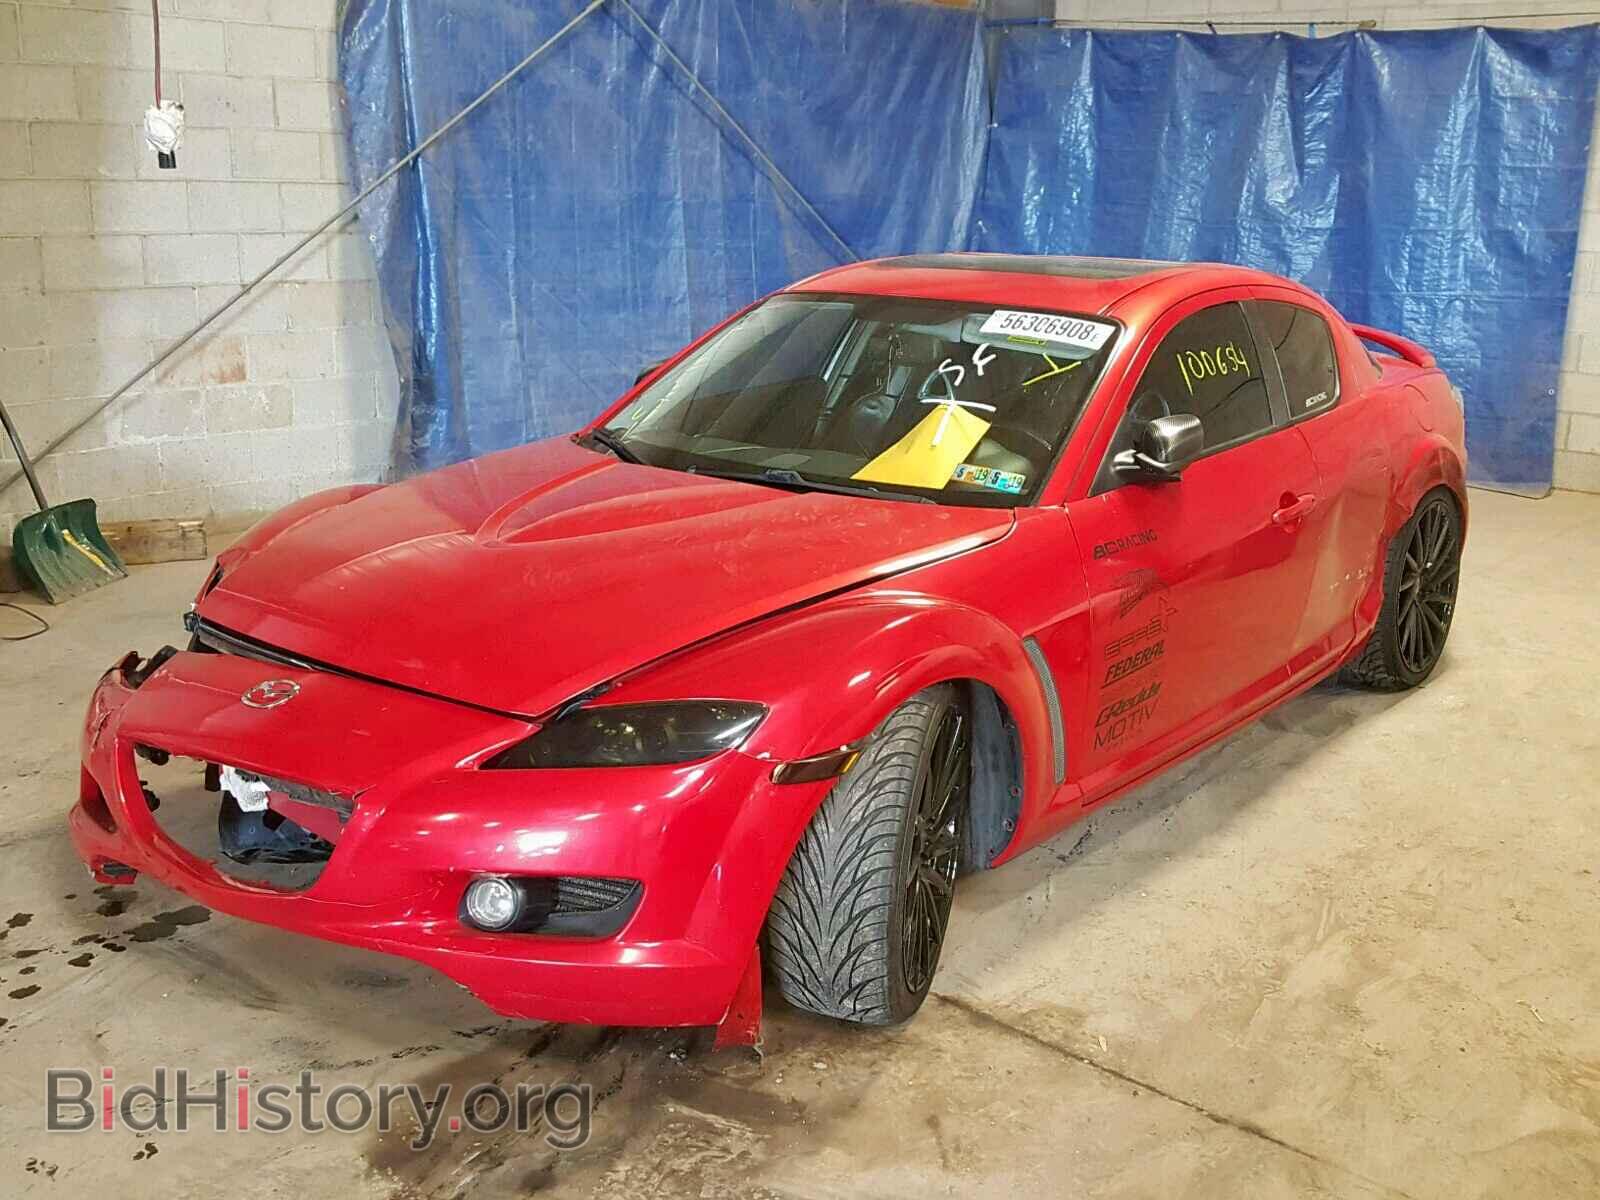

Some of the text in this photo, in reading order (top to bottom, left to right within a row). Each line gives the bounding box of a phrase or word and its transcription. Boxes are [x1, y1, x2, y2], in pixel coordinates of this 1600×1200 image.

[999, 313, 1096, 341] 56306908
[1104, 640, 1165, 683] FEDERAL
[1094, 700, 1160, 750] MOTIV
